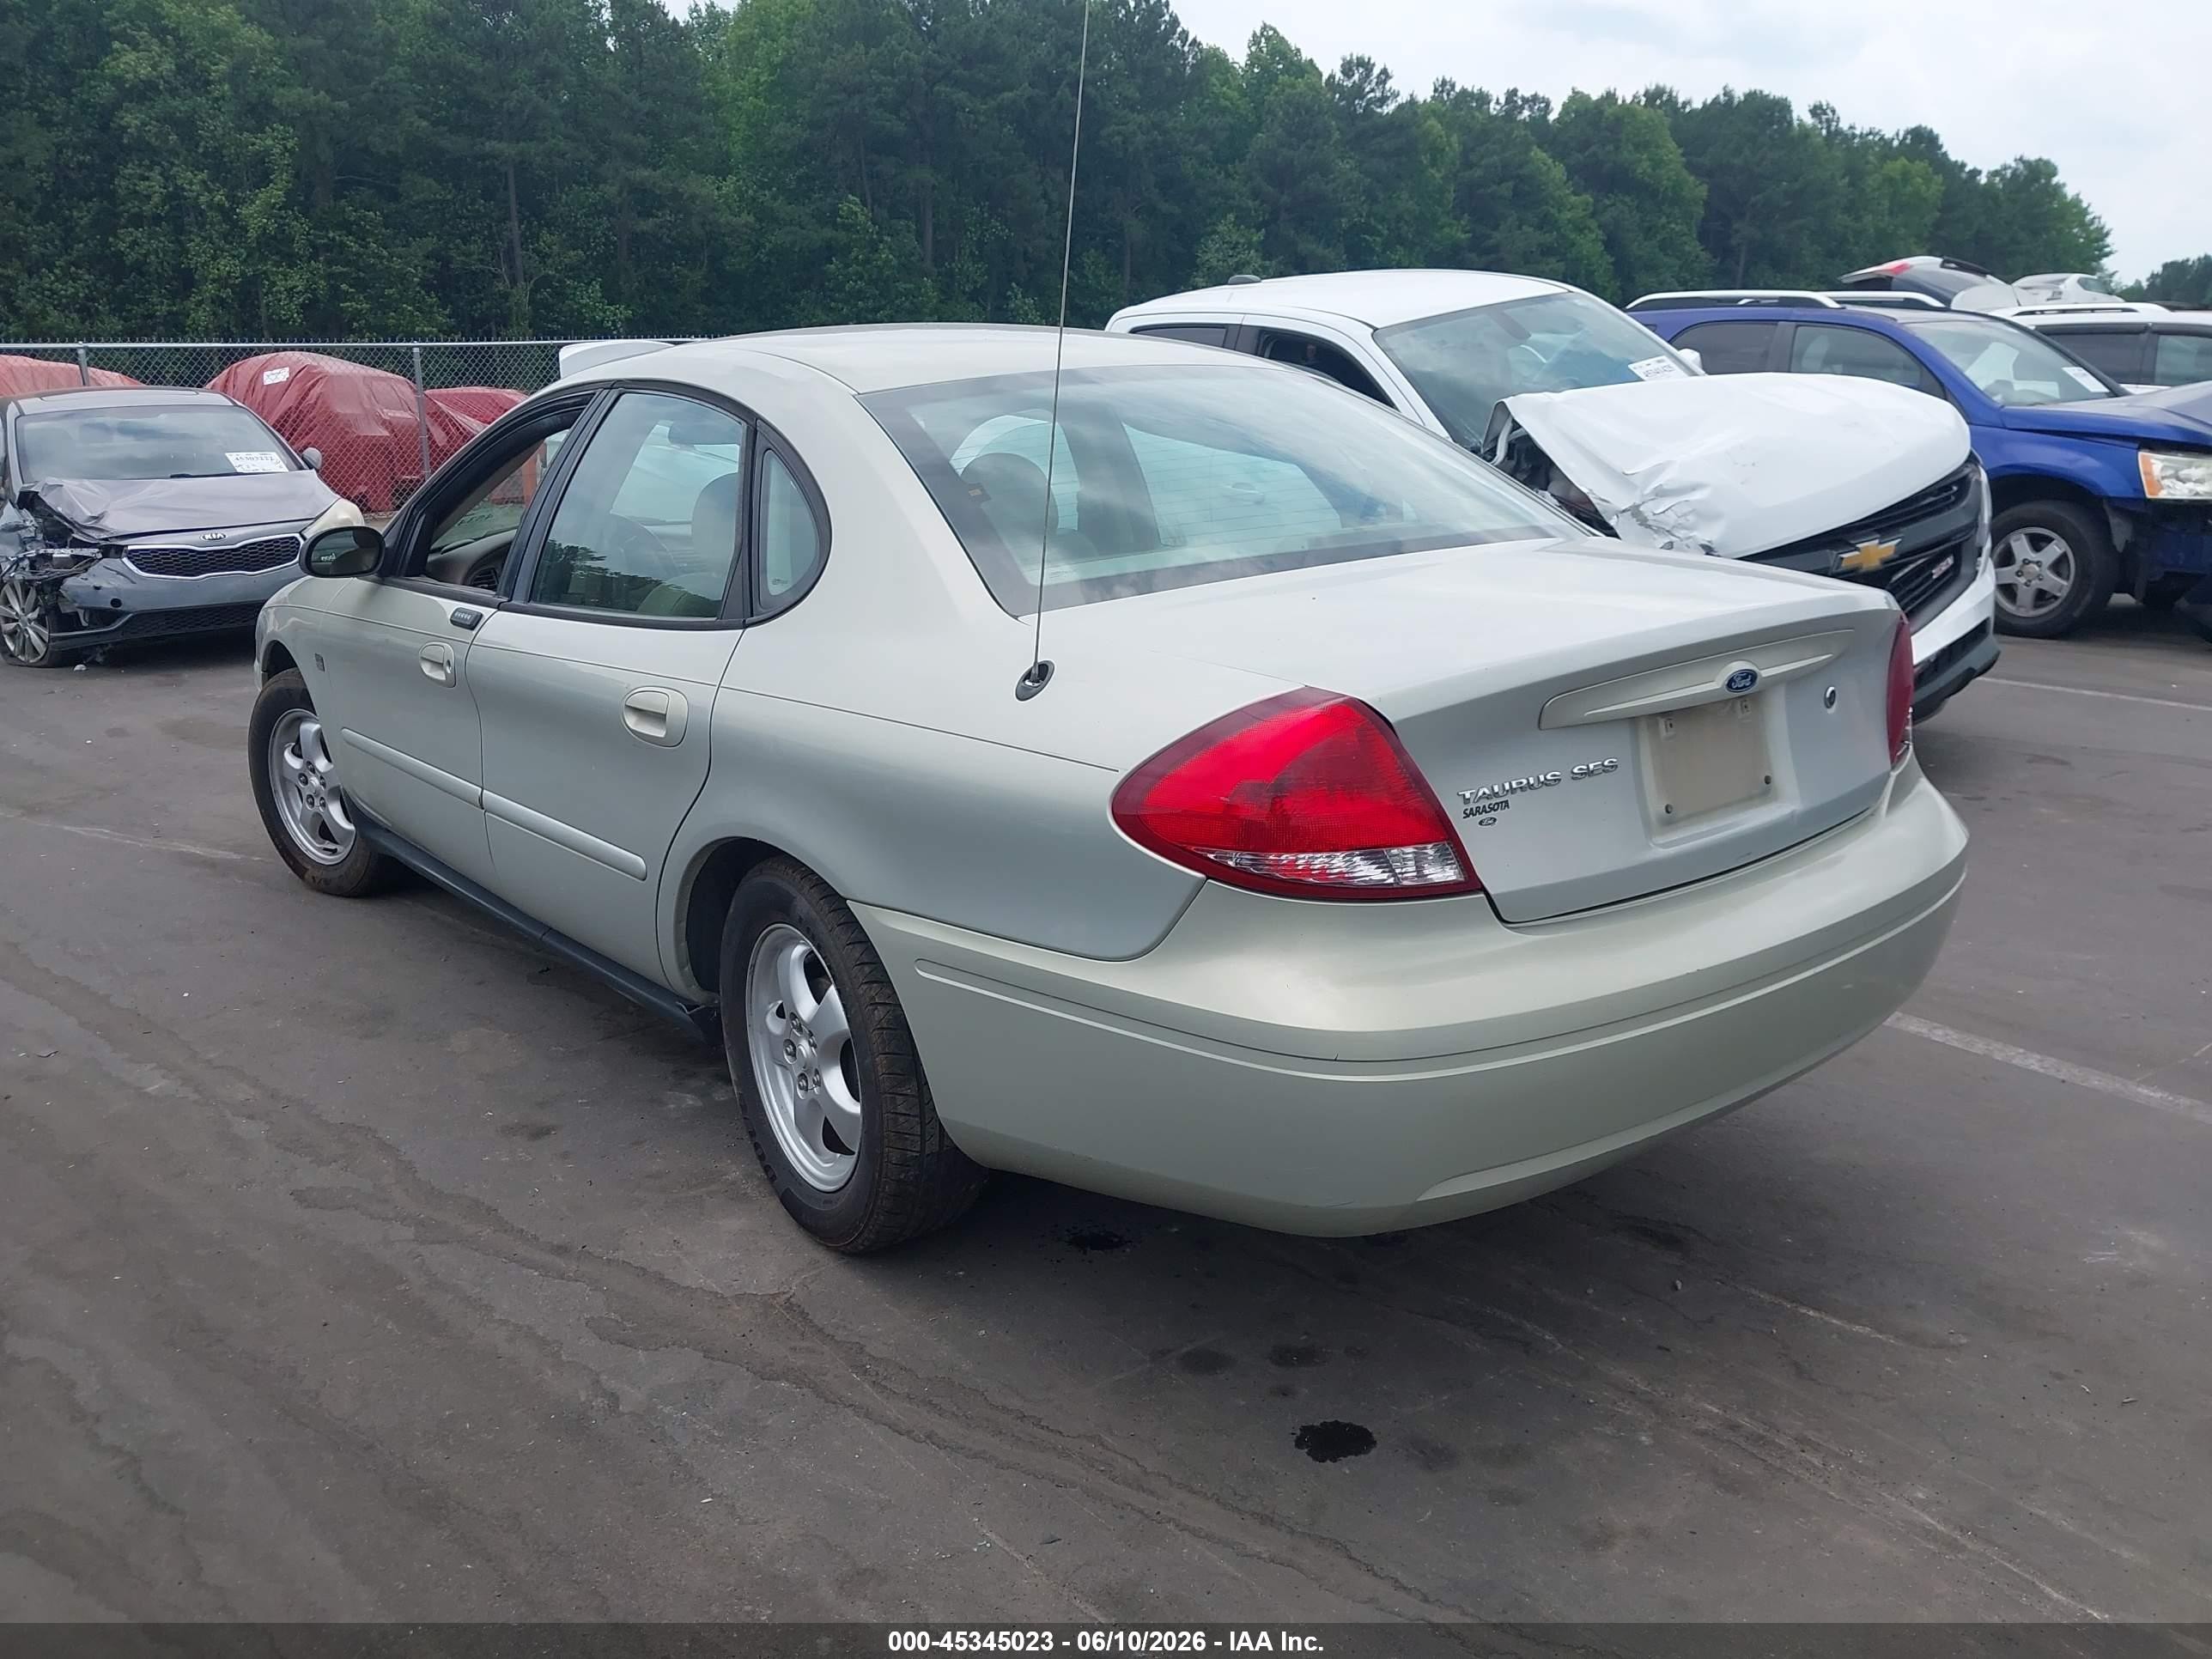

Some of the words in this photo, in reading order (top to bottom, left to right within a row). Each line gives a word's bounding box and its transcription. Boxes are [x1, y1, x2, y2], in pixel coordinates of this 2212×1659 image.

[1729, 672, 1753, 690] Ford
[1457, 771, 1562, 805] TAURUS
[1571, 757, 1619, 781] SES
[1462, 799, 1510, 819] SARASOTA
